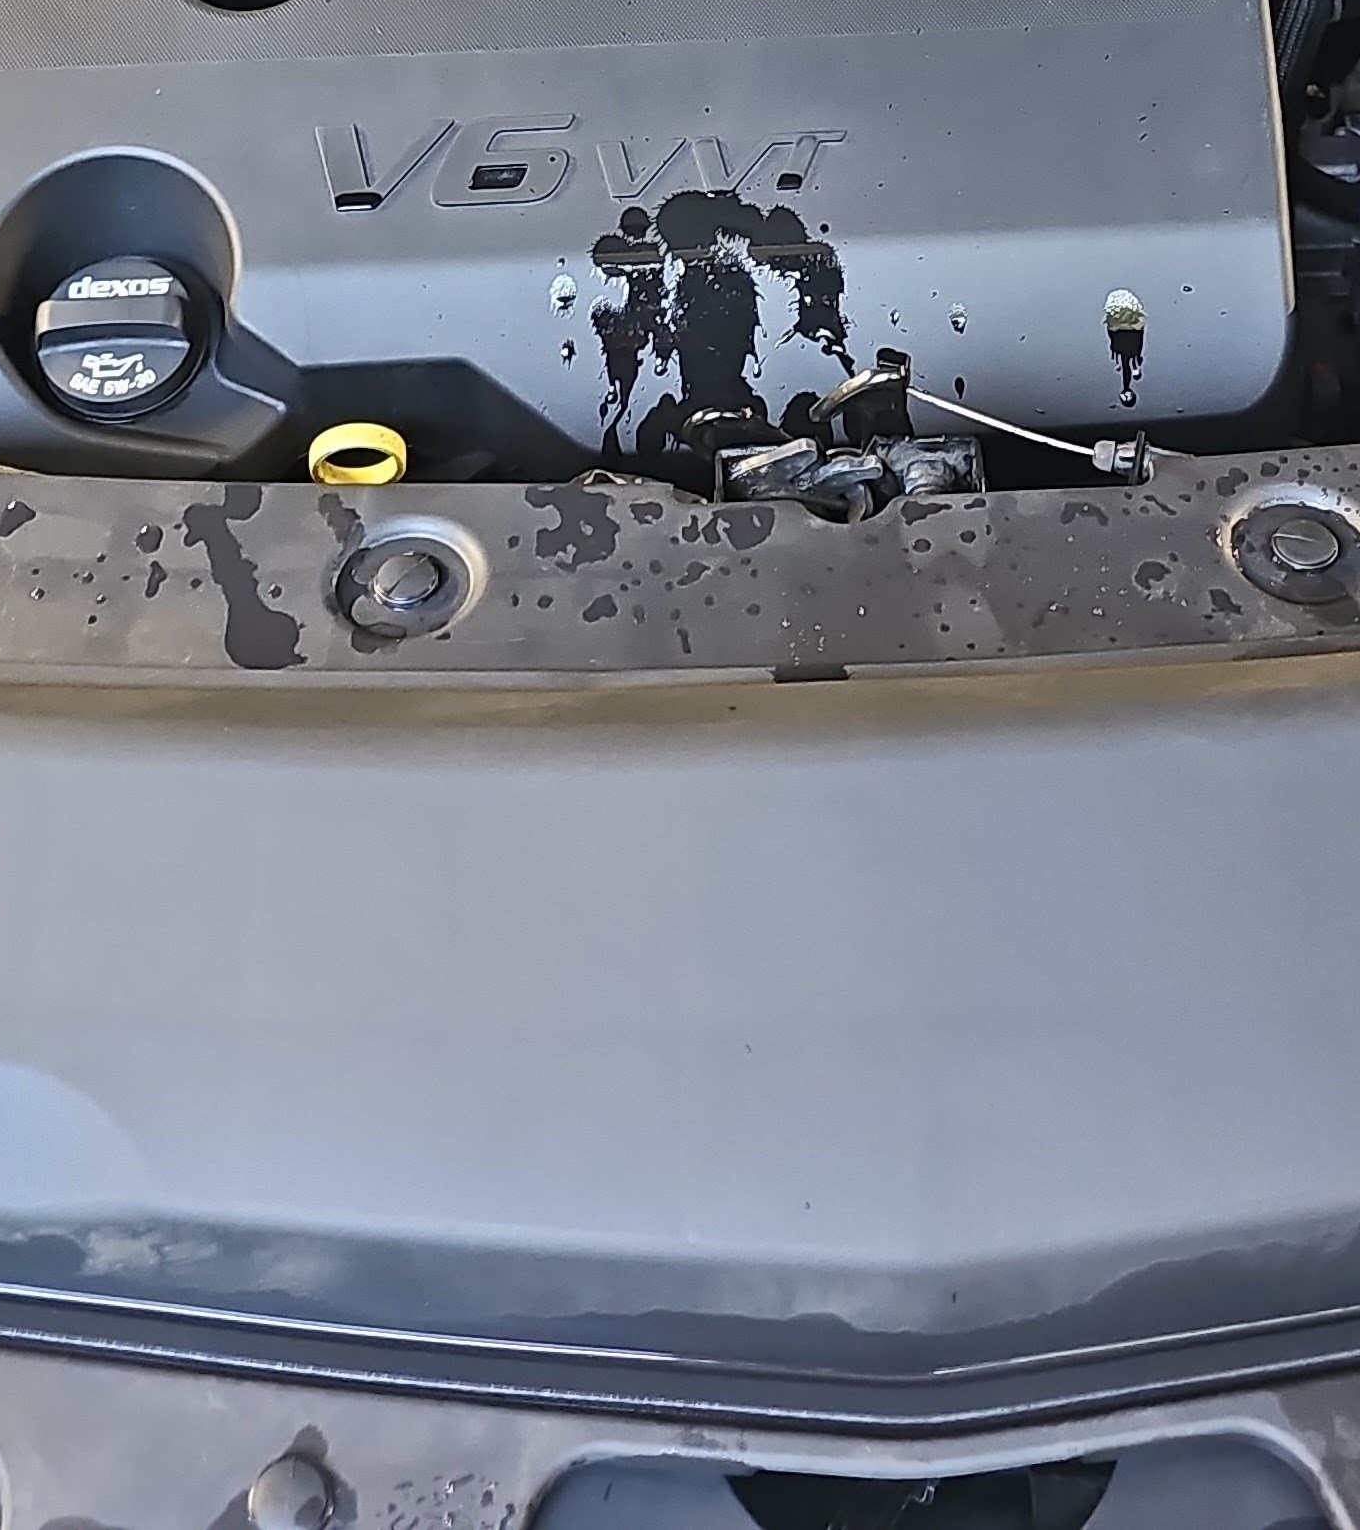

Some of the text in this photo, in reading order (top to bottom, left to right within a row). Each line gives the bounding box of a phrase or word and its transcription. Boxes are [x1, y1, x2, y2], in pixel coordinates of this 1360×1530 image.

[314, 113, 848, 213] V6 VVT
[69, 277, 173, 298] dexos
[71, 369, 156, 396] SAE 5W-30
